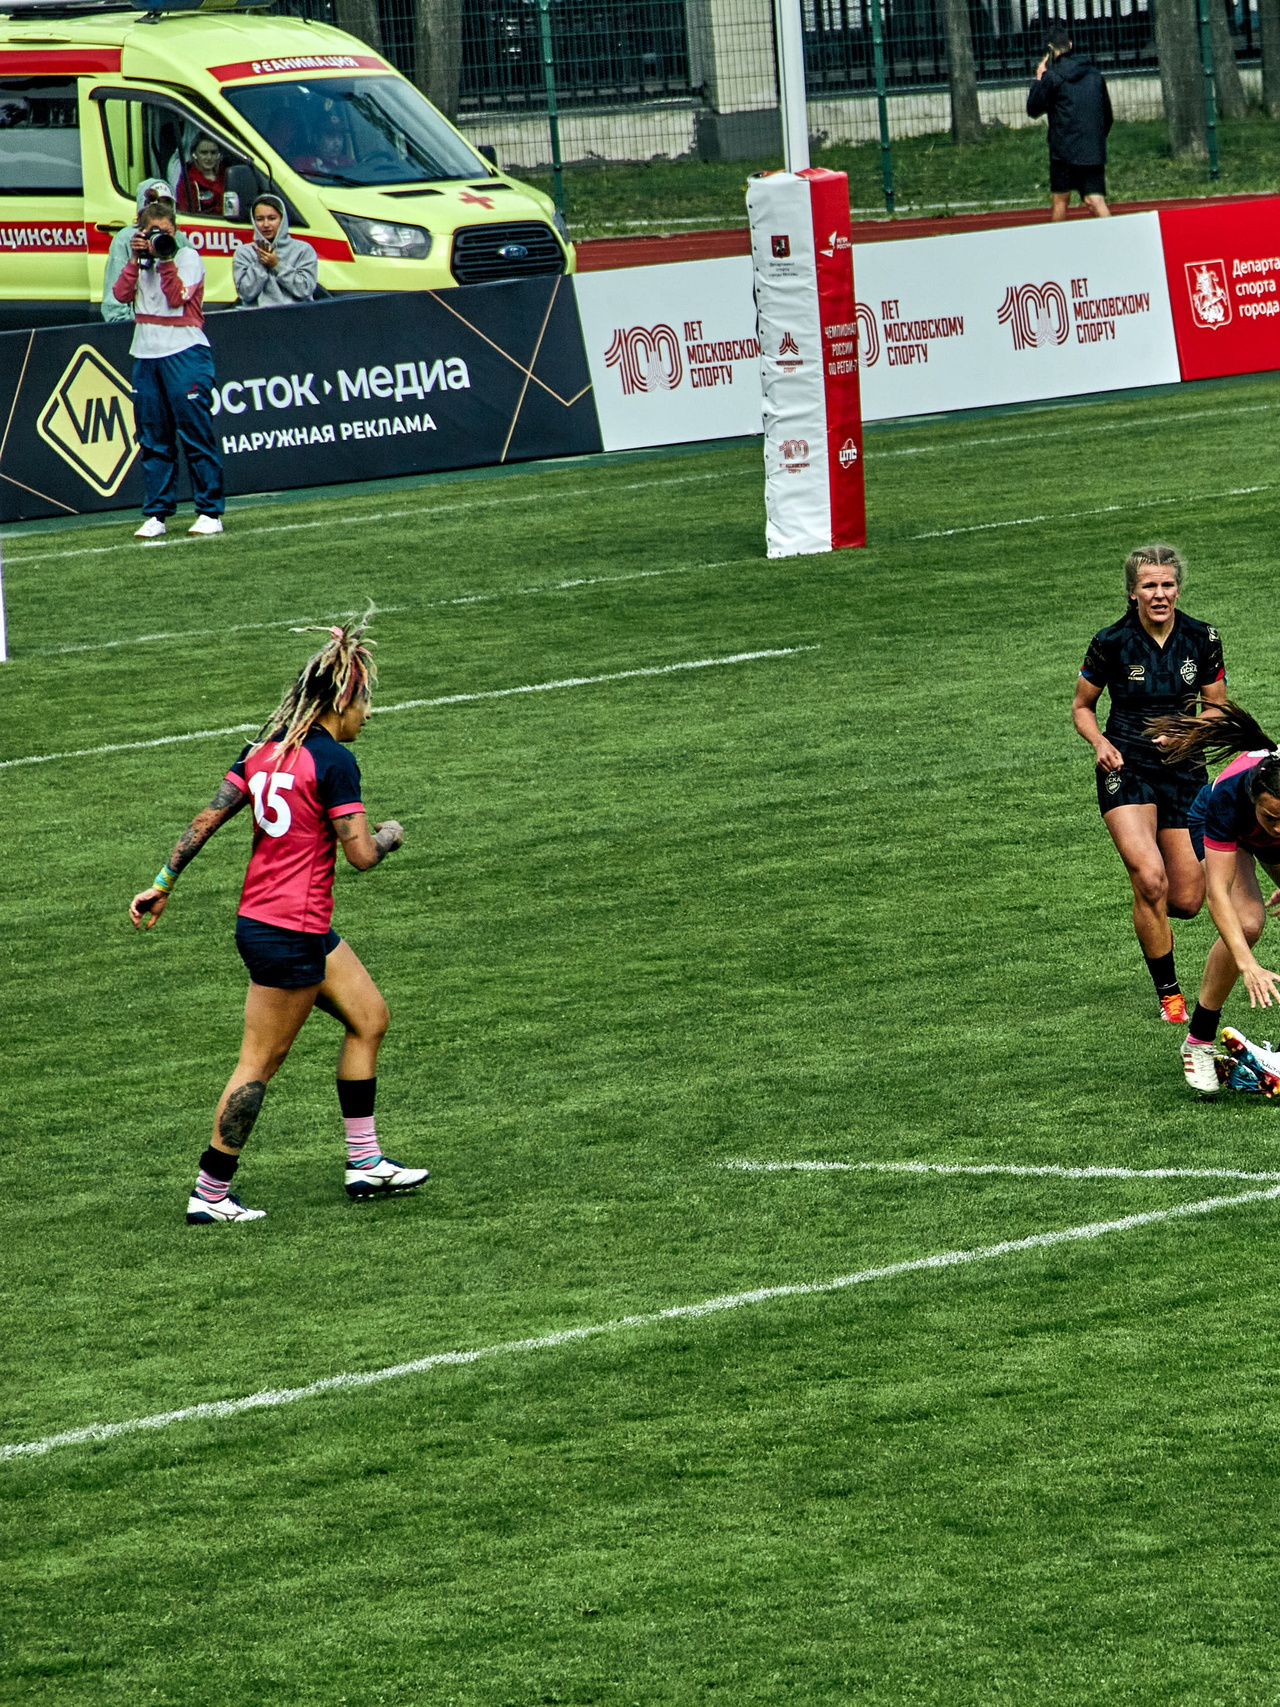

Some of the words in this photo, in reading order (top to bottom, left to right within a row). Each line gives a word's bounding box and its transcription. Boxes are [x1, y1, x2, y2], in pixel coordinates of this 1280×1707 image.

[251, 56, 359, 74] РЕАНИМАЦИЯ
[0, 228, 88, 249] ЦИНСКАЯ
[184, 231, 244, 253] ОЩЬ
[1071, 278, 1088, 298] ЛЕТ
[1235, 279, 1276, 297] спорта
[881, 300, 900, 320] ЛЕТ
[997, 281, 1070, 351] 100
[1073, 293, 1150, 321] МОСКОВСКОМУ
[1239, 300, 1280, 320] города
[684, 320, 703, 342] ЛЕТ
[824, 322, 857, 339] ЧЕМПИОНАТ
[884, 316, 964, 343] МОСКОВСКОМУ
[1076, 321, 1116, 344] СПОРТУ
[604, 323, 683, 395] 100
[686, 338, 762, 365] МОСКОВСКОМ
[832, 342, 854, 357] РОССИИ
[887, 344, 929, 367] СПОРТУ
[690, 365, 732, 388] СПОРТУ
[222, 424, 336, 455] НАРУЖНАЯ
[340, 413, 437, 441] РЕКЛАМА
[248, 771, 295, 838] 15
